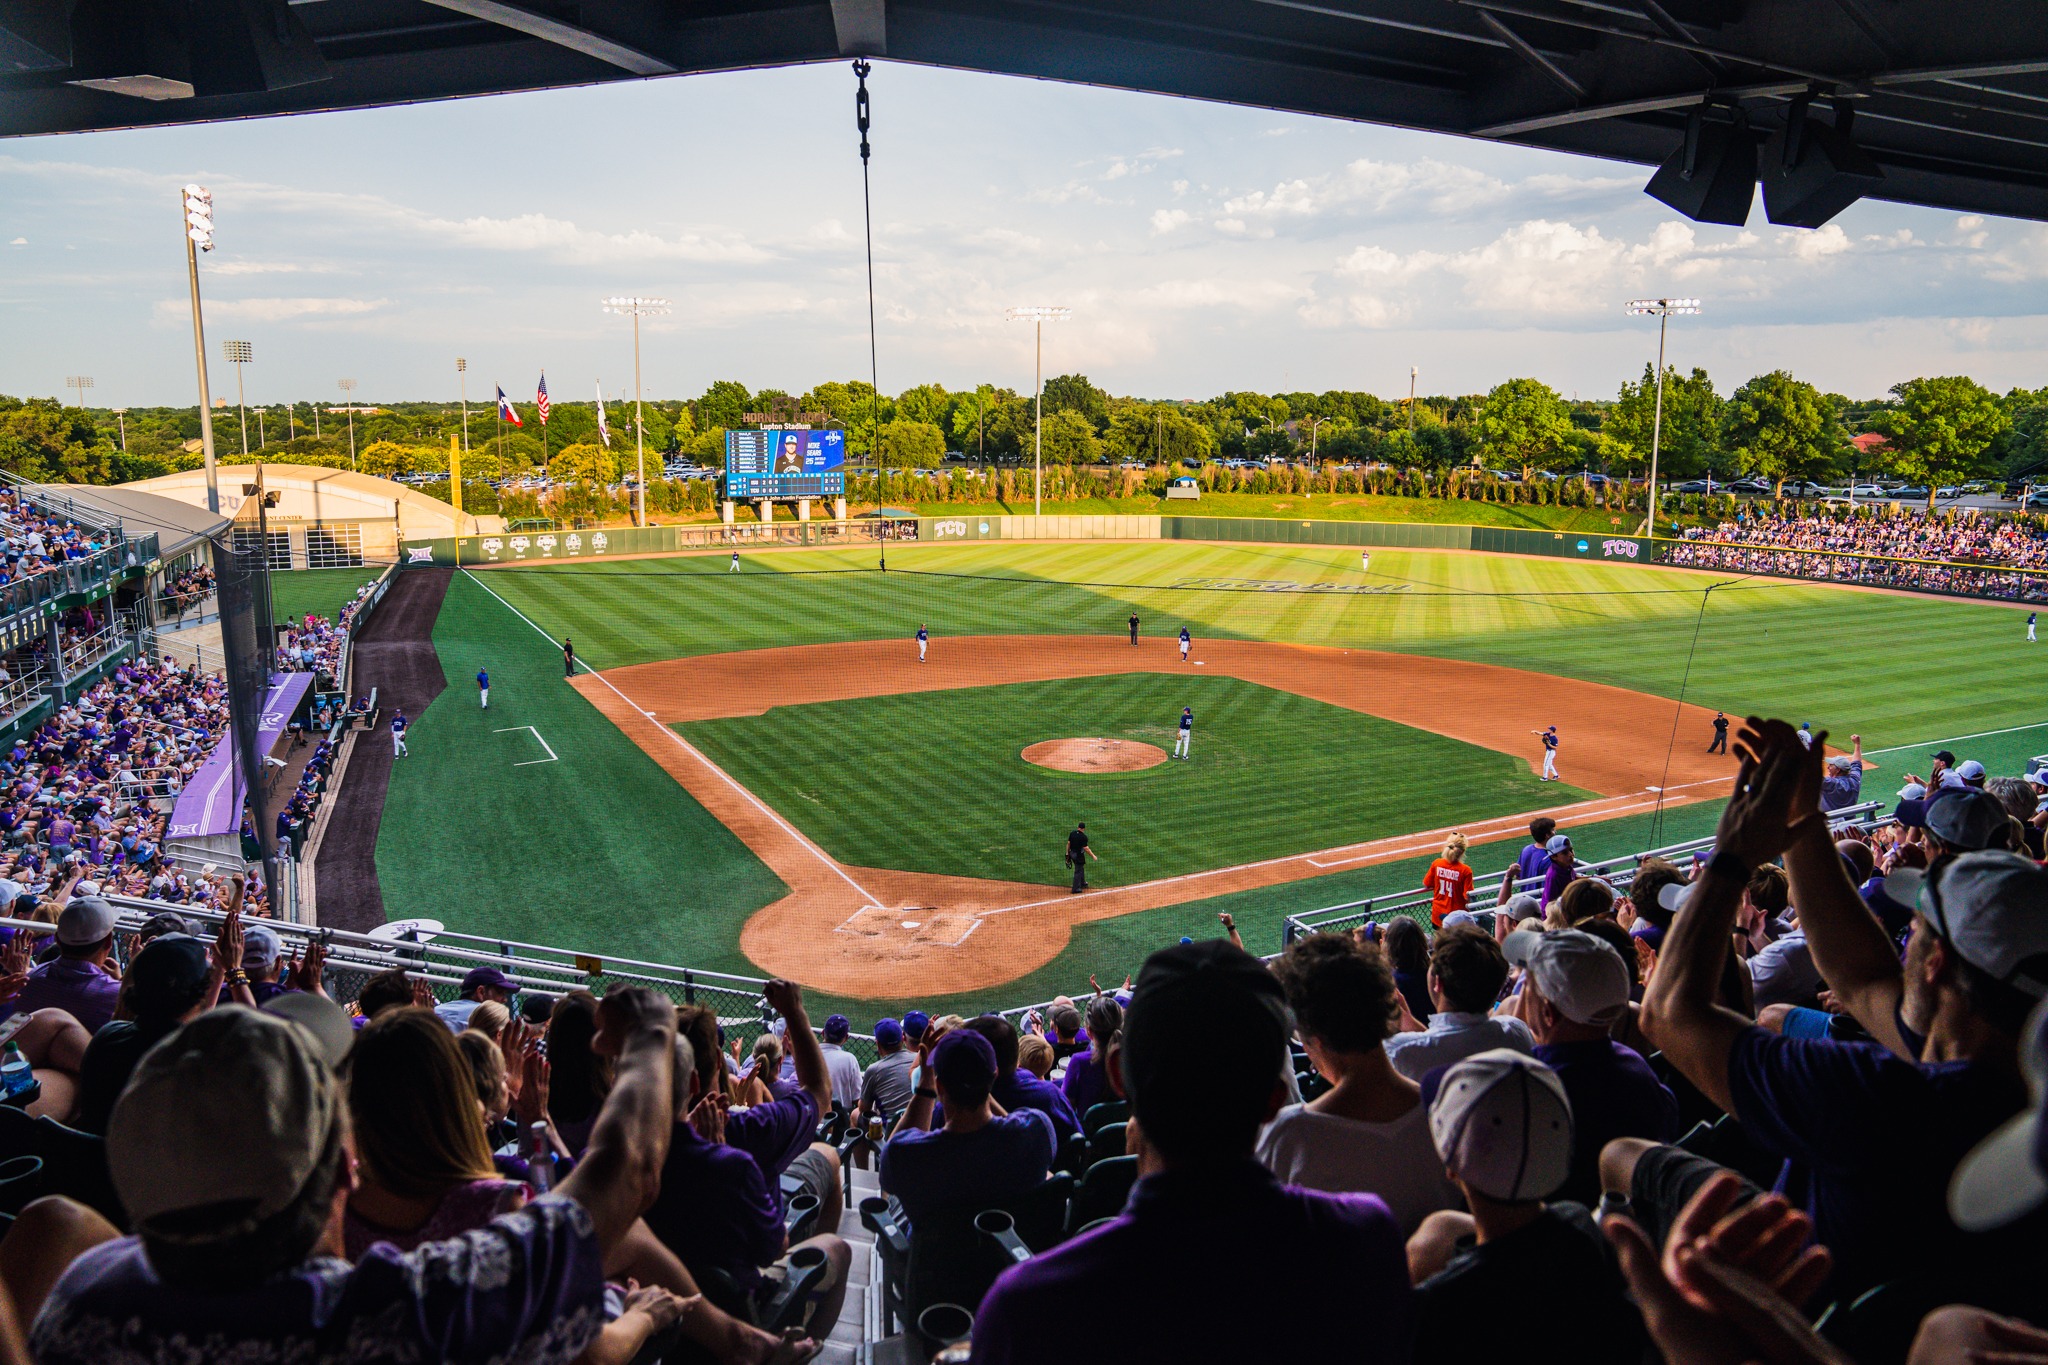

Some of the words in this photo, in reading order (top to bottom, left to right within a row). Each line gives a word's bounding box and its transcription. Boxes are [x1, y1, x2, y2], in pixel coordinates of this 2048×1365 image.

[742, 412, 786, 422] HORNED
[760, 422, 782, 431] Lupton
[784, 422, 811, 430] Stadium
[202, 495, 240, 511] CU
[935, 520, 967, 537] TCU
[1602, 539, 1639, 558] TCU
[1439, 879, 1454, 898] 14
